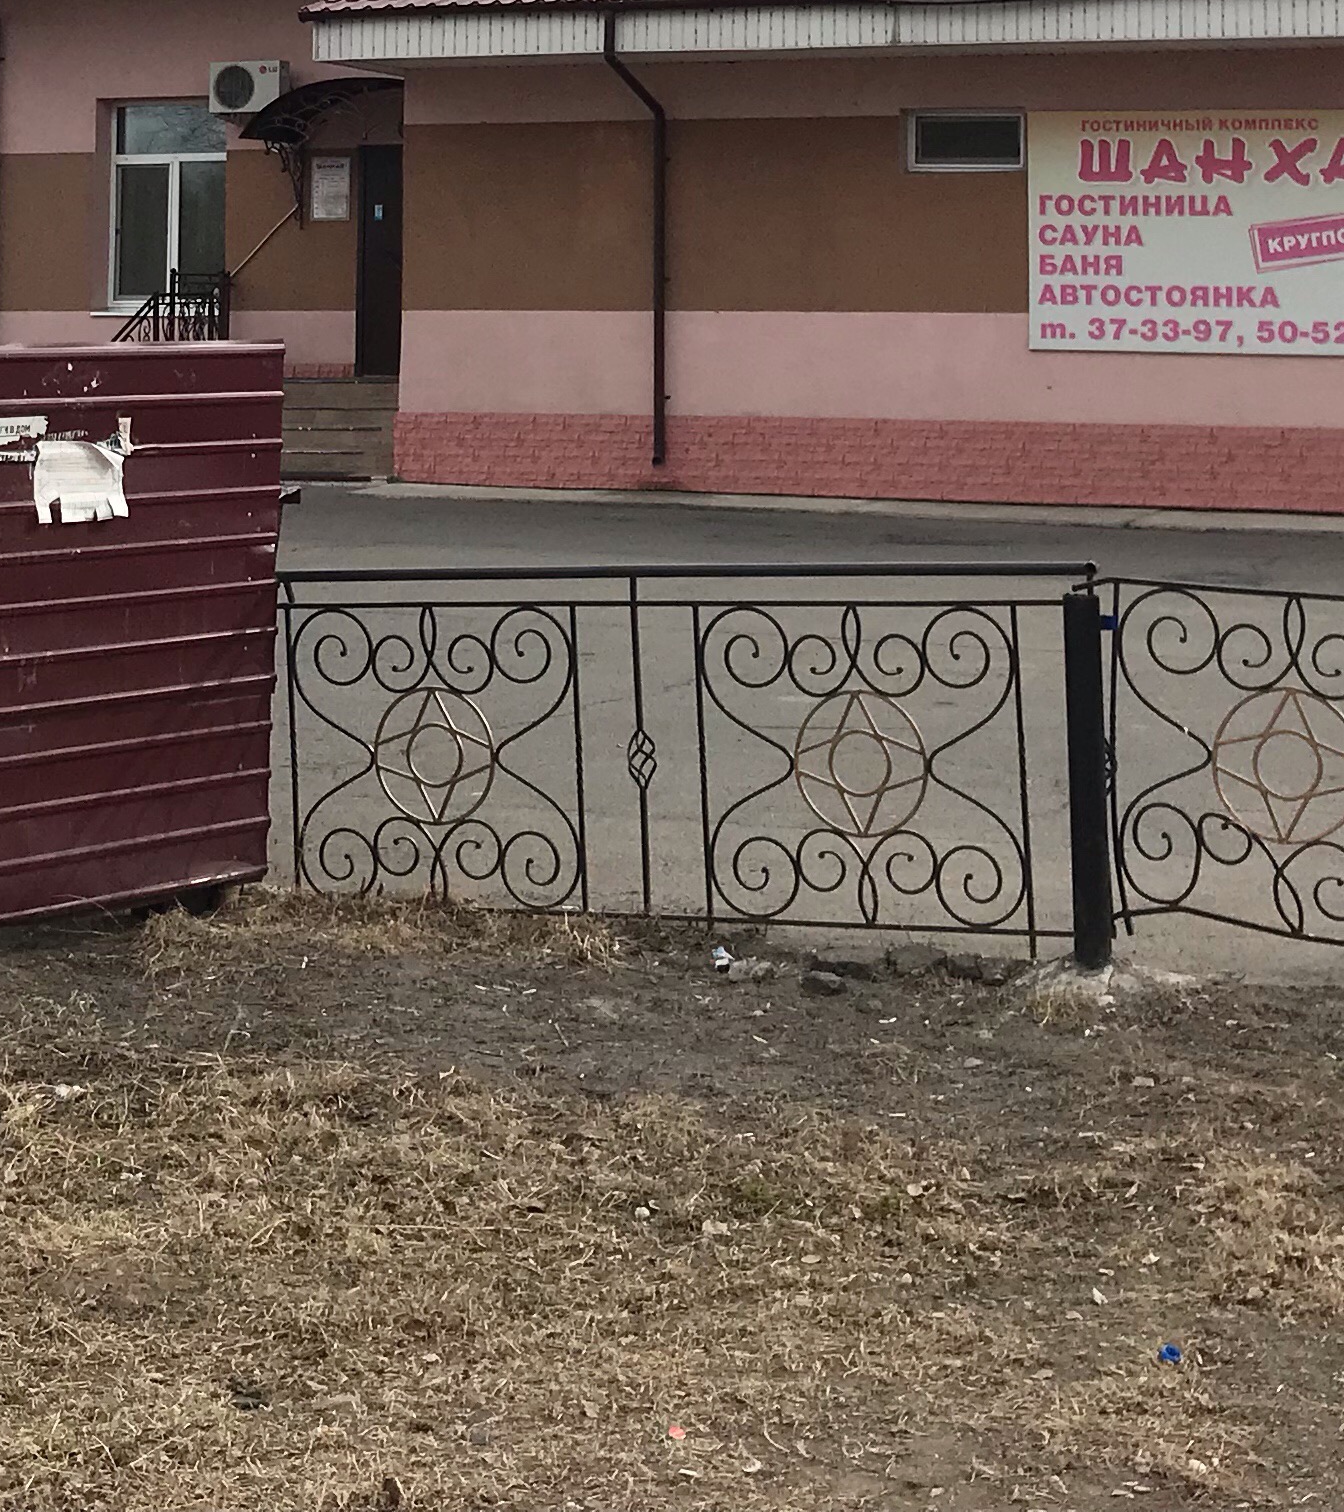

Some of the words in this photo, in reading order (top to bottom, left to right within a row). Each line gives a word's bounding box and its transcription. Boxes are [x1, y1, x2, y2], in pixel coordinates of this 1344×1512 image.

[1081, 117, 1213, 132] ГОСТИНИЧНЫЙ
[1218, 118, 1319, 131] КОМПЛЕКС
[1038, 194, 1233, 218] ГОСТИНИЦА
[1038, 224, 1143, 246] САУНА
[1038, 254, 1124, 276] БАНЯ
[1038, 284, 1281, 308] АВТОСТОЯНКА
[1088, 317, 1244, 347] 37-33-97,
